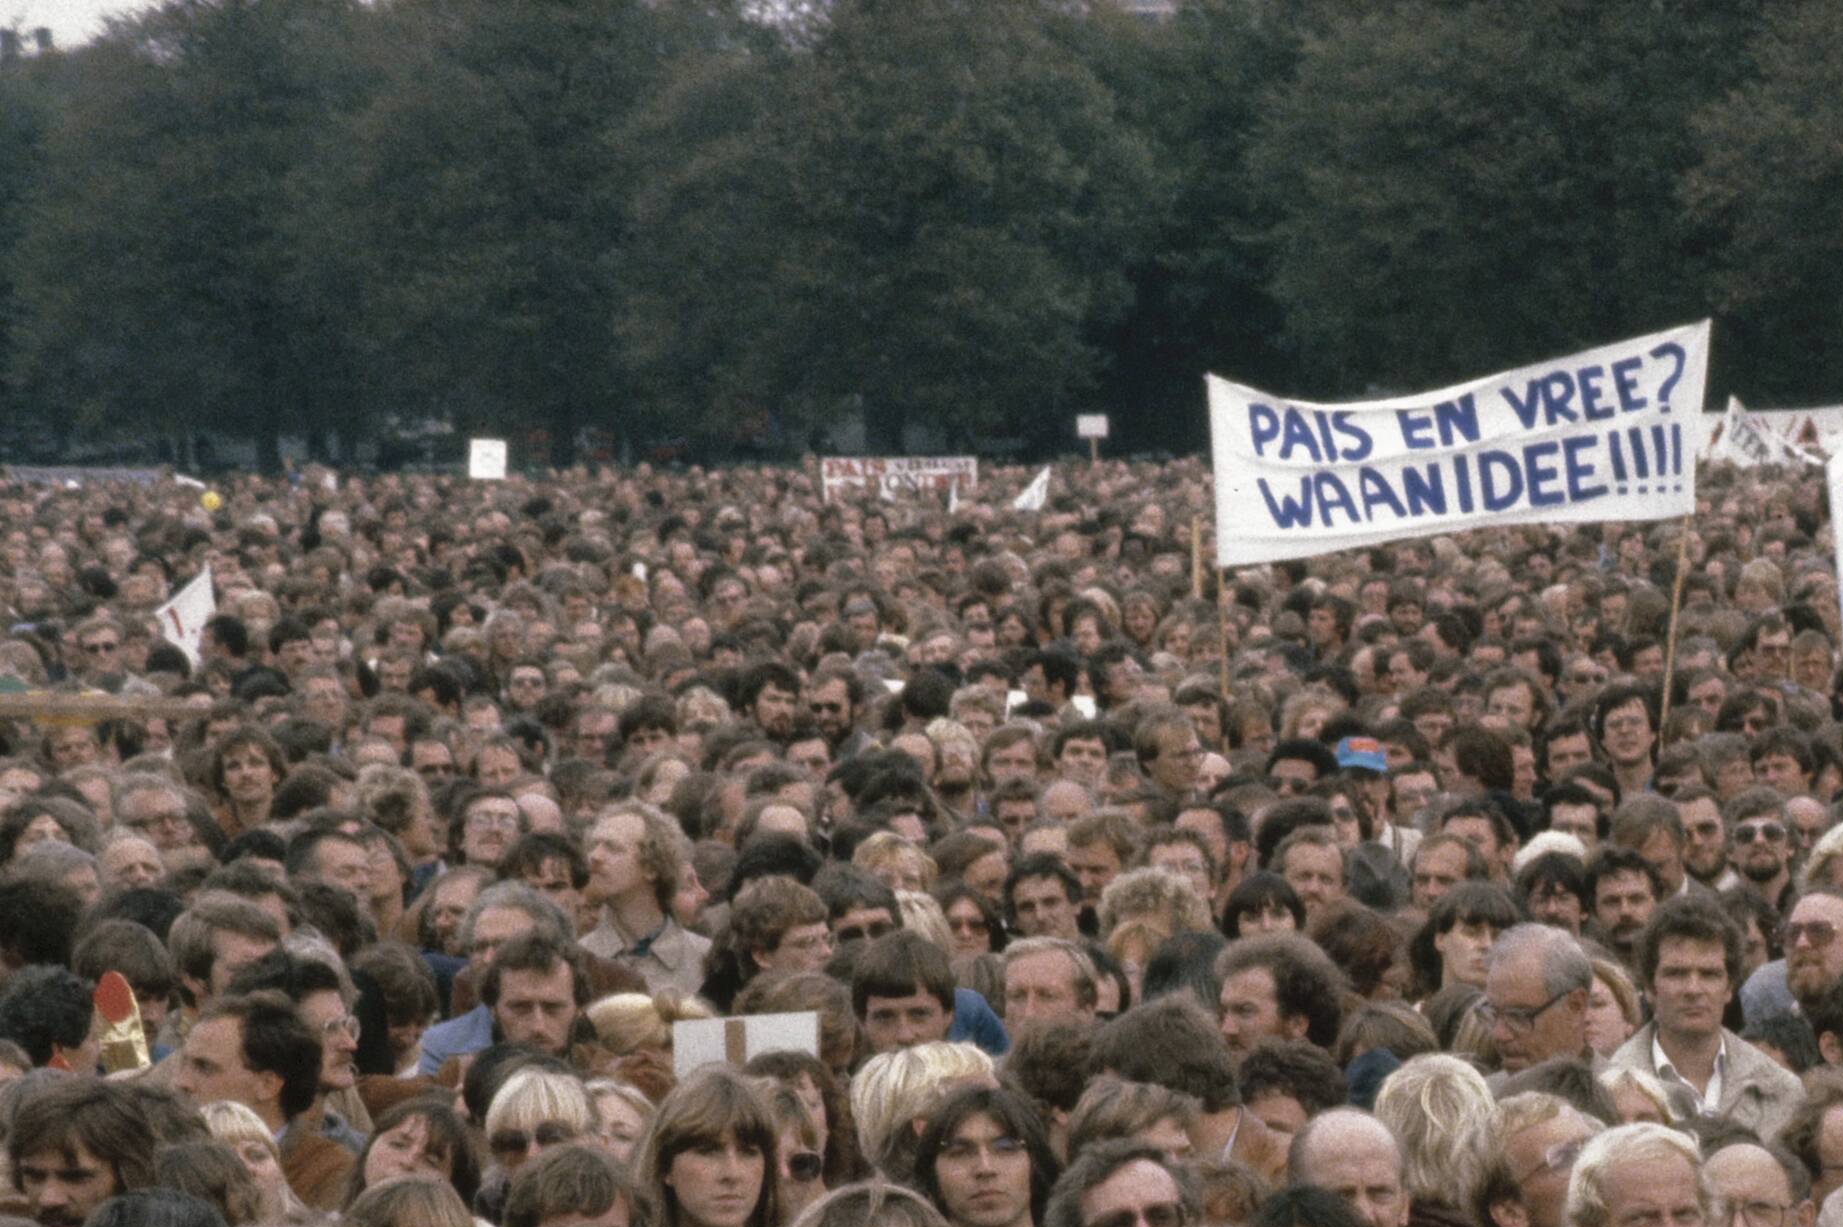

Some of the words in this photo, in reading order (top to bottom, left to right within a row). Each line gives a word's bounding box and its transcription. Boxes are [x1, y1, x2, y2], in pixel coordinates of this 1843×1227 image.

[1248, 403, 1373, 462] PAIS
[1395, 392, 1480, 449] EN
[1499, 341, 1686, 430] VREE?
